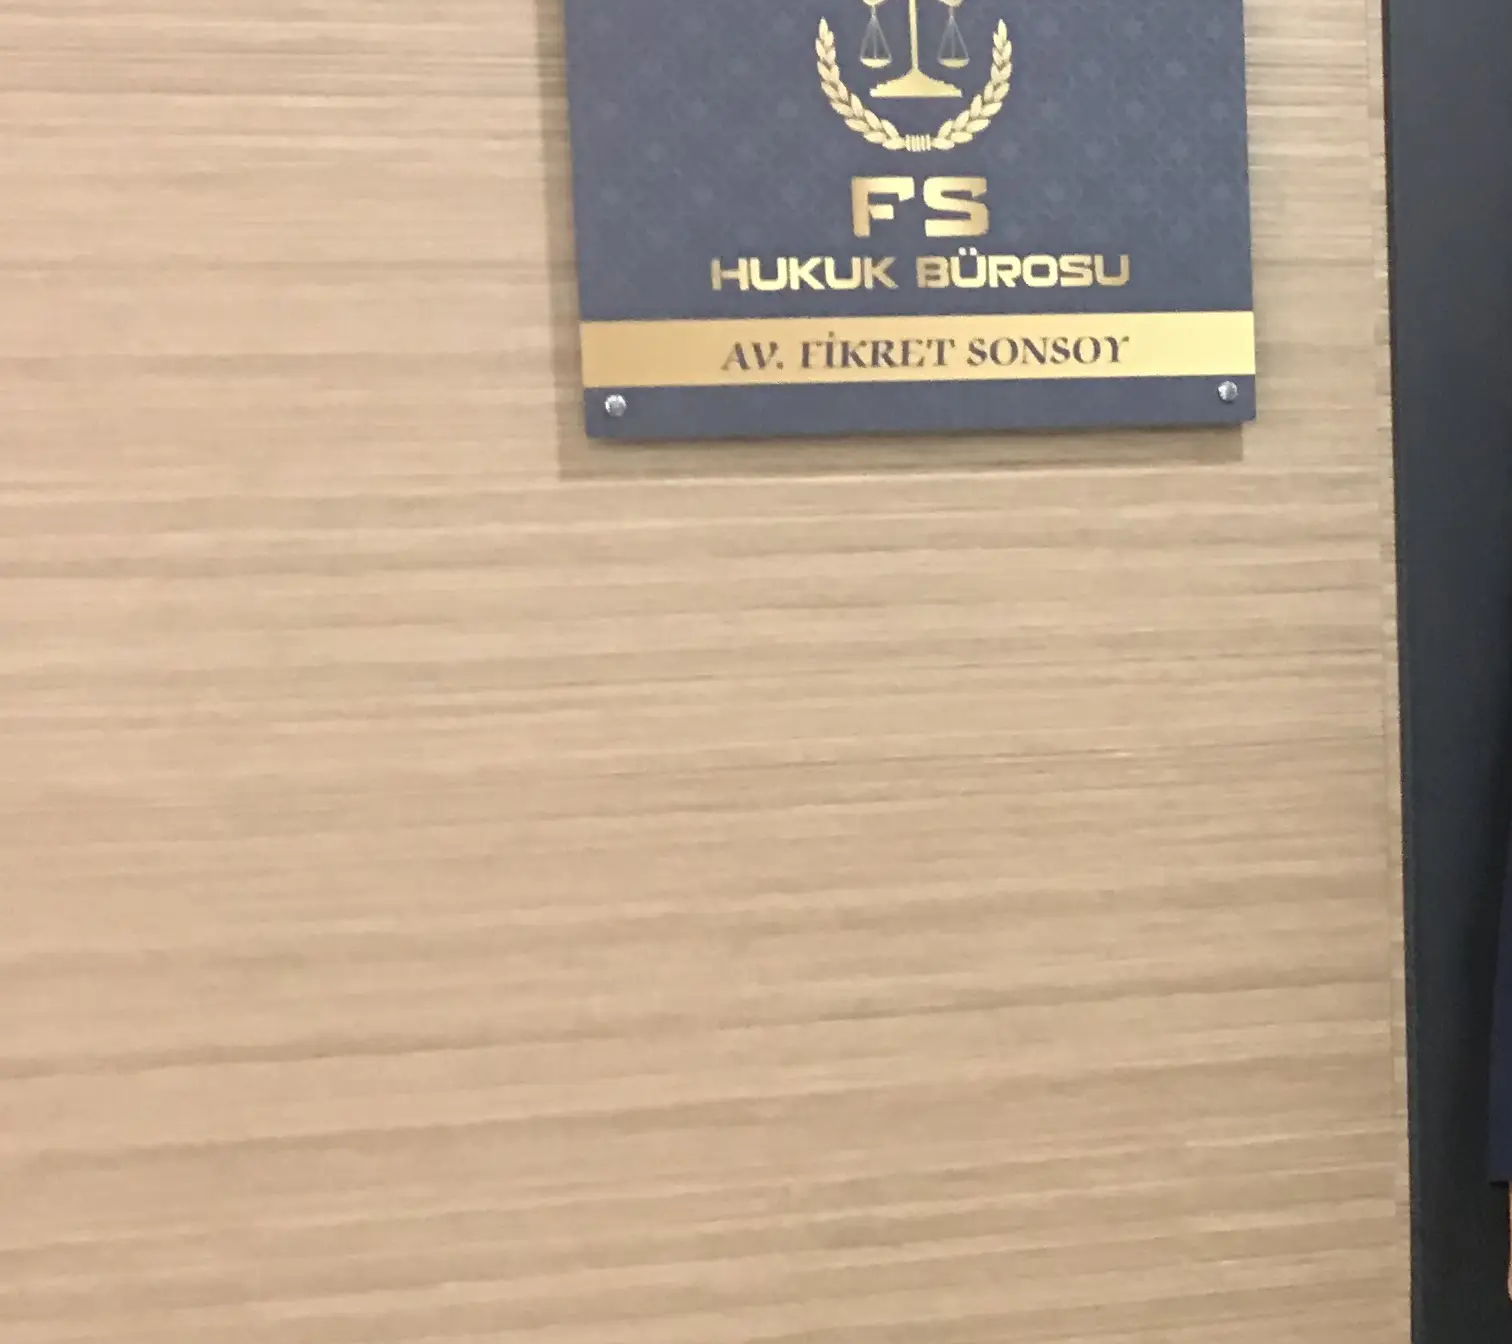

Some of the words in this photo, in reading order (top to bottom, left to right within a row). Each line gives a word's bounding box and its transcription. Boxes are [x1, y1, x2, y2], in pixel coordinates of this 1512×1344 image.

[851, 175, 989, 237] FS
[710, 256, 899, 291] HUKUK
[915, 246, 1131, 288] BÜROSU
[720, 340, 784, 370] AV.
[799, 330, 956, 369] FİKRET
[966, 334, 1130, 367] SONSOY
